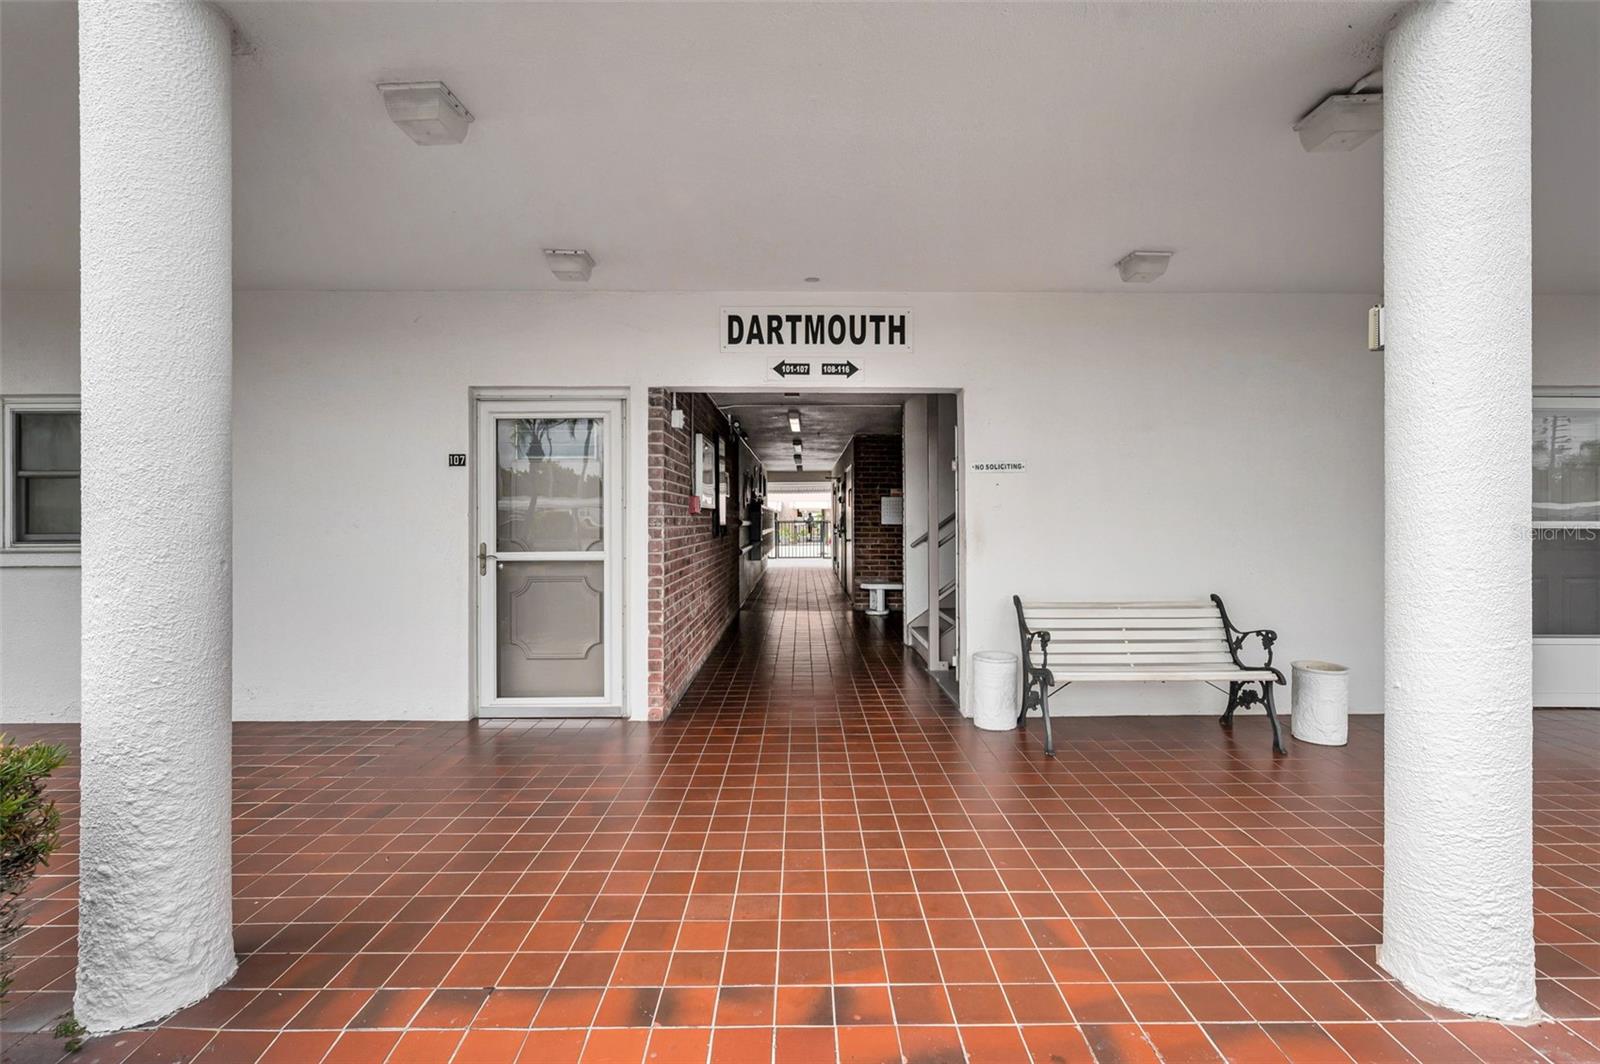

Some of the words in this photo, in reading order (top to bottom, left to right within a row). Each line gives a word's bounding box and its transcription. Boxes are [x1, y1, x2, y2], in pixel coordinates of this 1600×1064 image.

[728, 314, 906, 345] DARTMOUTH
[781, 365, 809, 373] 101-107
[823, 365, 850, 373] 108-116
[450, 455, 465, 465] 107
